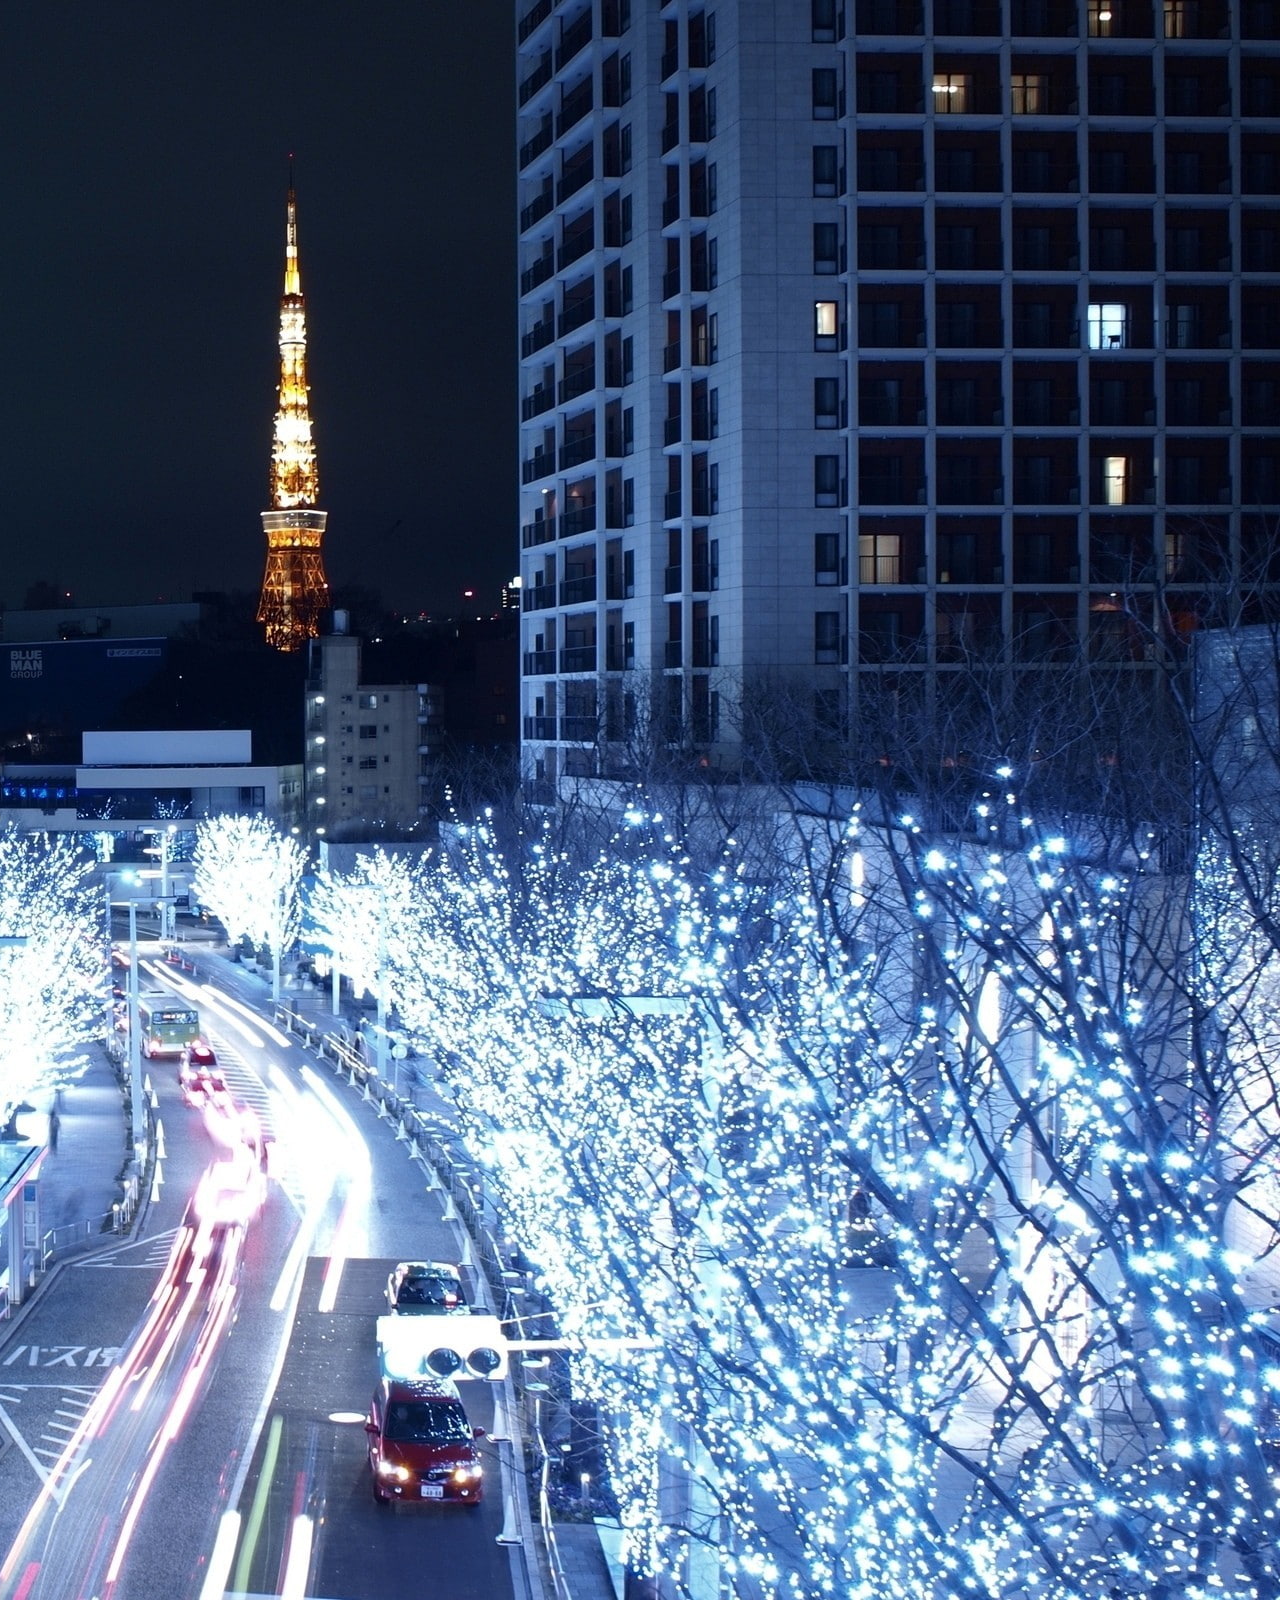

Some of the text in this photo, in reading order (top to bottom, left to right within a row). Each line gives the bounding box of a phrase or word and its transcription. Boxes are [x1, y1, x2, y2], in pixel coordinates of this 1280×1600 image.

[10, 650, 42, 660] BLUE
[10, 660, 42, 671] MAN
[10, 671, 43, 679] GROUP
